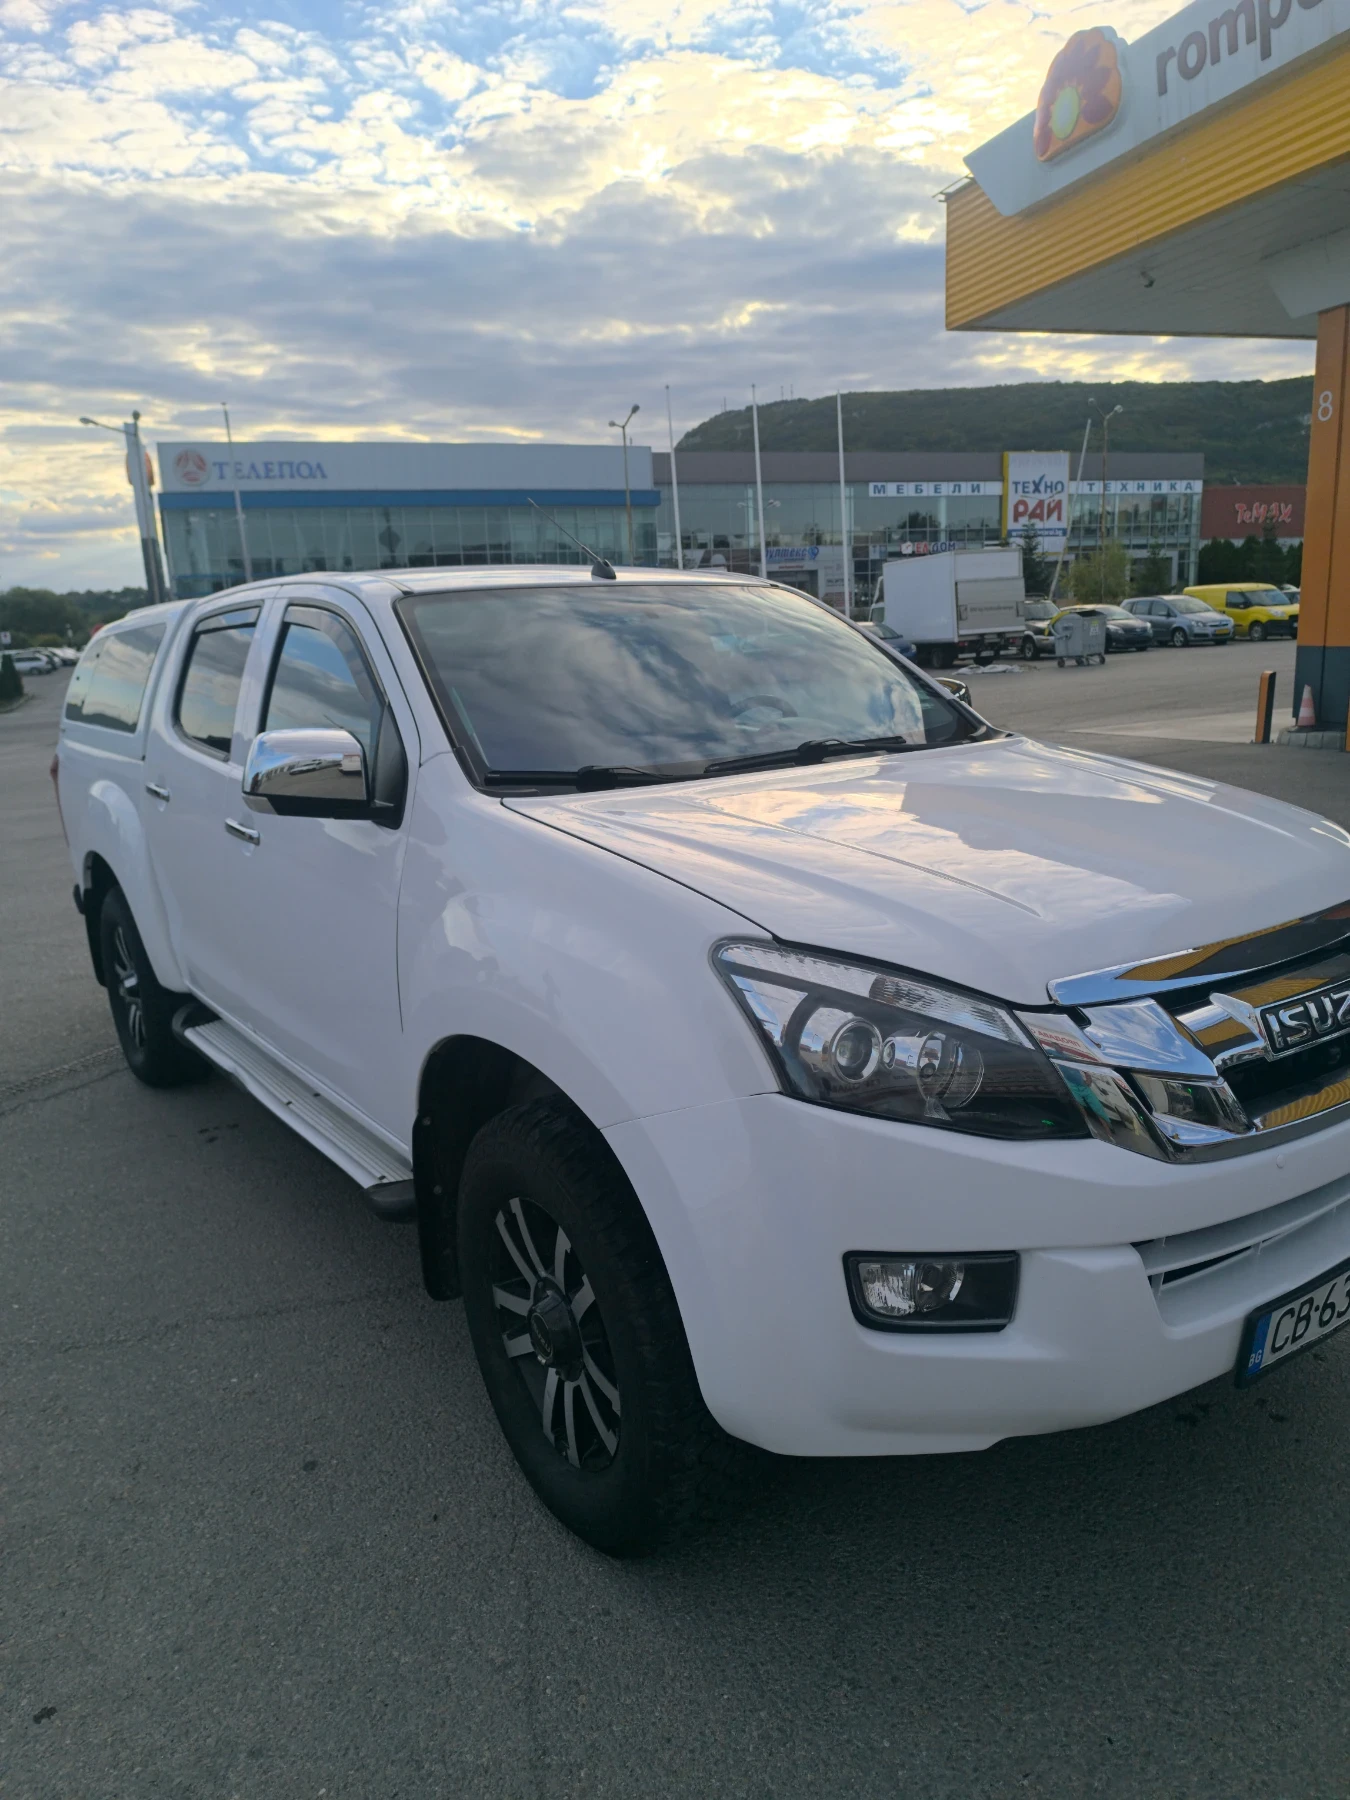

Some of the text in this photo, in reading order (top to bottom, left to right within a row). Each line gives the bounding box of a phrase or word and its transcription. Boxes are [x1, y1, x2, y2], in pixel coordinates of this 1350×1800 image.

[1317, 391, 1334, 422] 8
[212, 461, 328, 480] ТЕЛЕПОЛ
[873, 484, 981, 495] МЕБЕЛИ
[1012, 474, 1065, 495] ТЕХНО
[1087, 482, 1193, 492] ТЕХНИКА
[1013, 499, 1063, 523] РАЙ
[1248, 1349, 1263, 1367] BG
